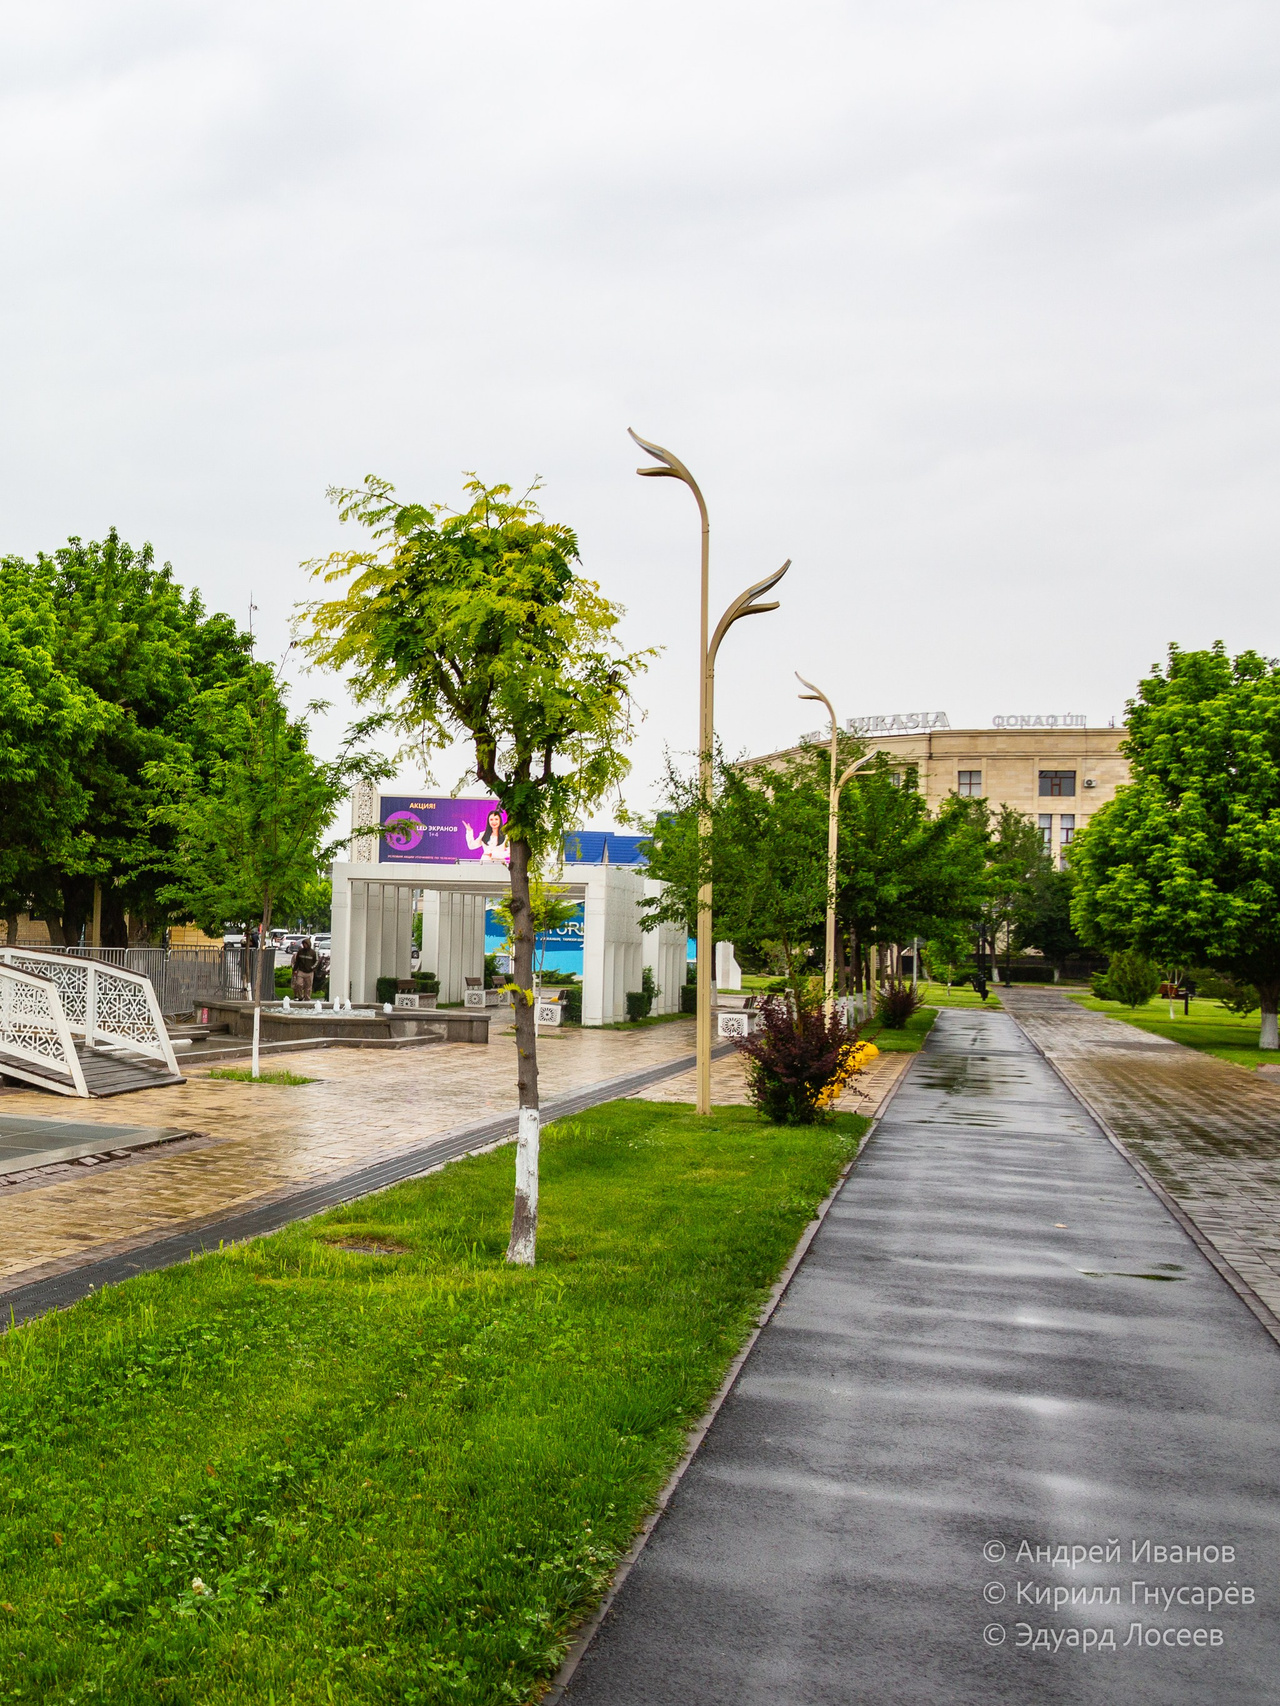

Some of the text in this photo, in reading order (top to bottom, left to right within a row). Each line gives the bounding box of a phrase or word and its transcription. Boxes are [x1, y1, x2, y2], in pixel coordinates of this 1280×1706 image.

[846, 711, 948, 734] EURASIA
[992, 714, 1058, 728] QONAQ
[409, 802, 436, 810] АКЦИЯ!
